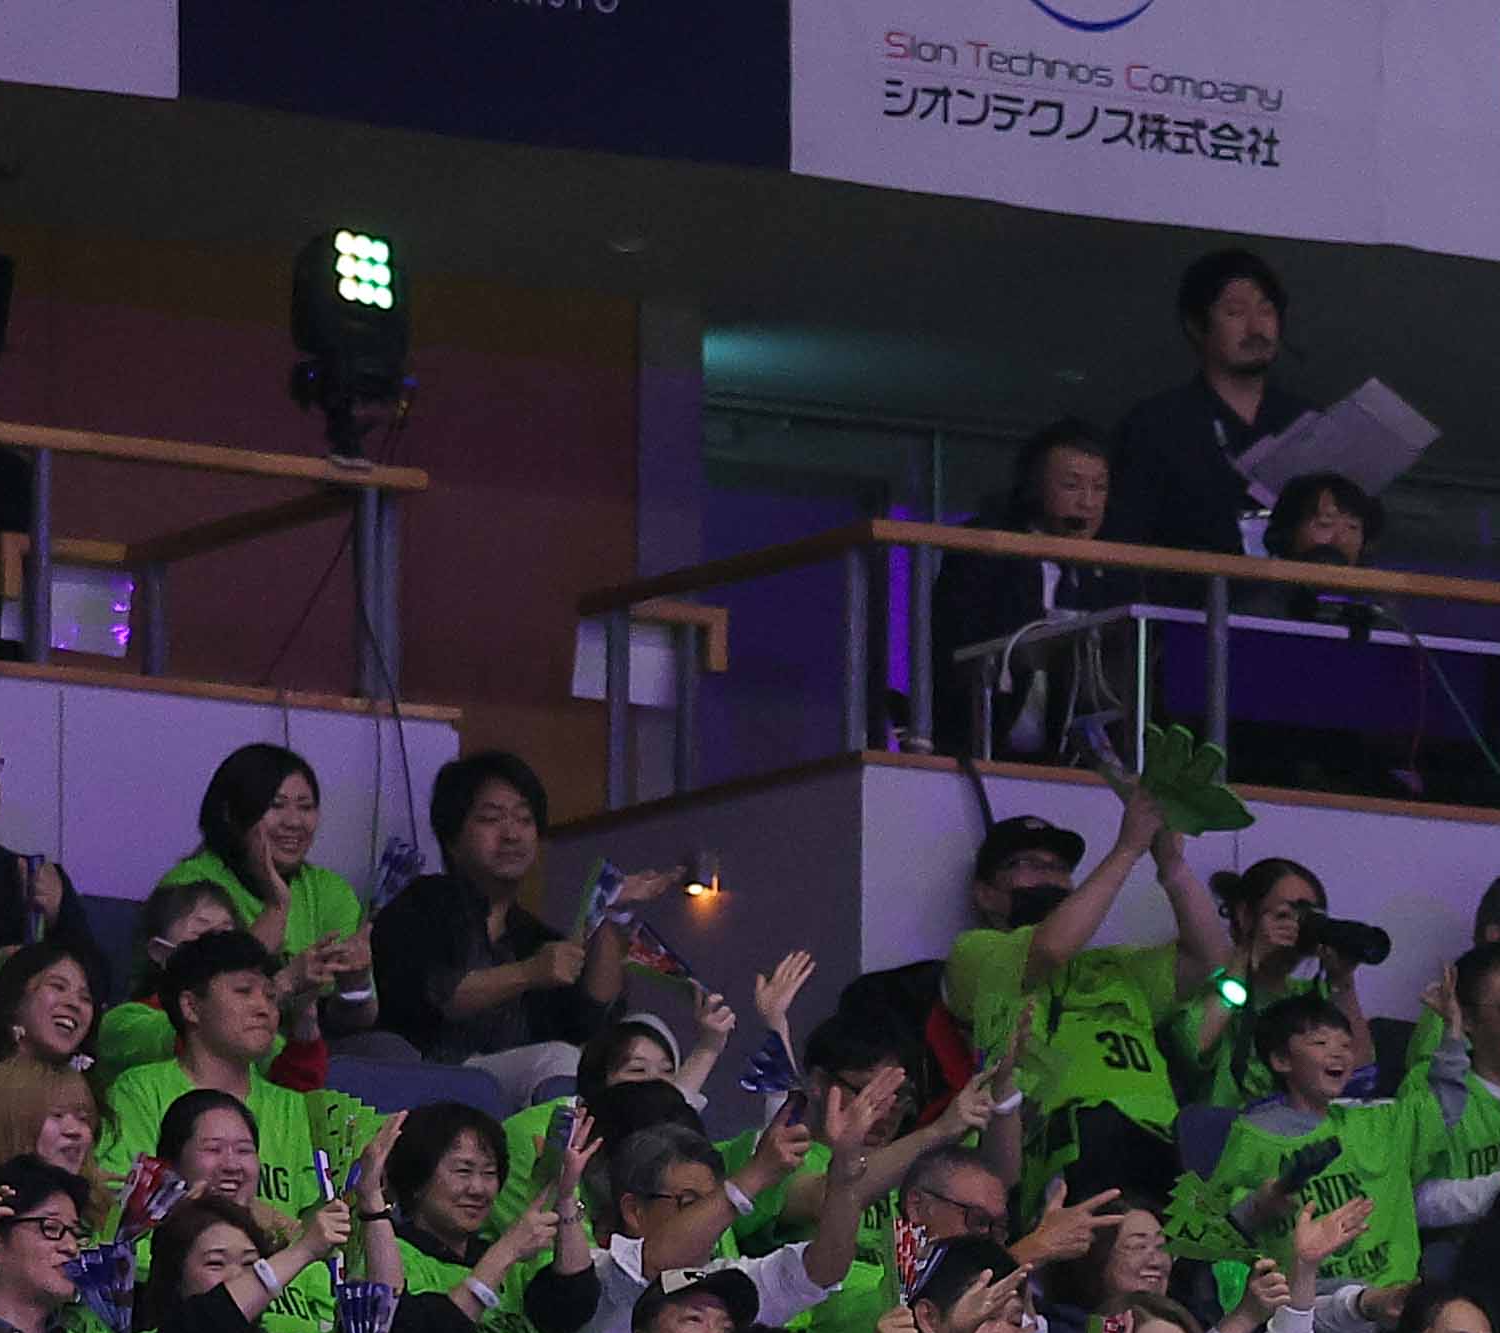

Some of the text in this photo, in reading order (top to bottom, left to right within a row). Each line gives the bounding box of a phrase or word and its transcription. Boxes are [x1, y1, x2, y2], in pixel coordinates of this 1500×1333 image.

[967, 40, 1113, 88] Technos
[1125, 65, 1284, 112] Company
[883, 79, 1281, 167] シオンテクノス株式会社
[1096, 1029, 1153, 1073] 30
